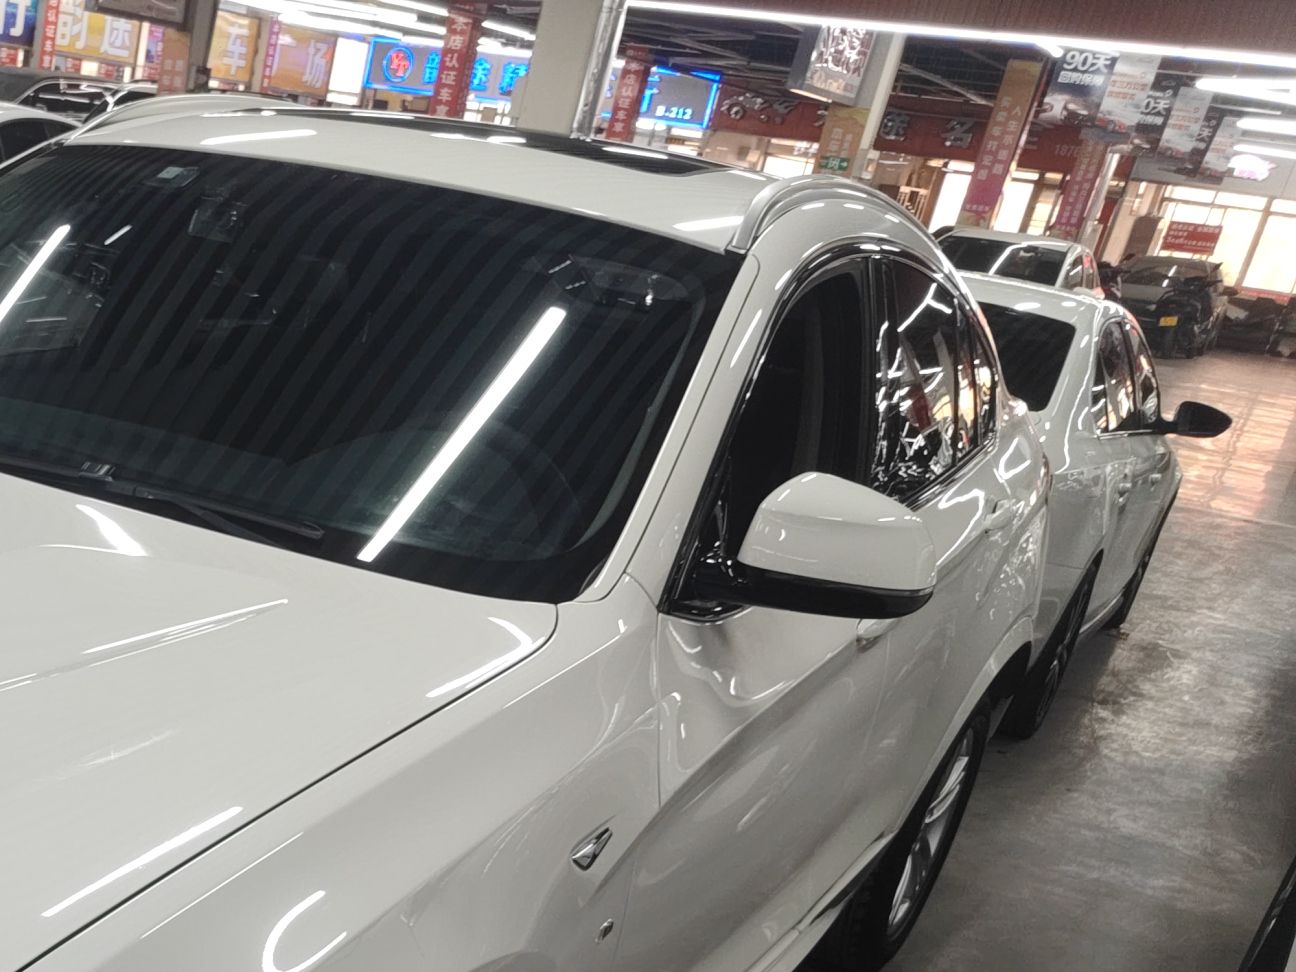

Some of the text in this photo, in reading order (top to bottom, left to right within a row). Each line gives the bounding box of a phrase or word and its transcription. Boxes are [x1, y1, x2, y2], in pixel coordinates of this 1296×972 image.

[222, 24, 250, 76] 车
[1063, 50, 1113, 73] 90天
[1139, 97, 1171, 116] 0天
